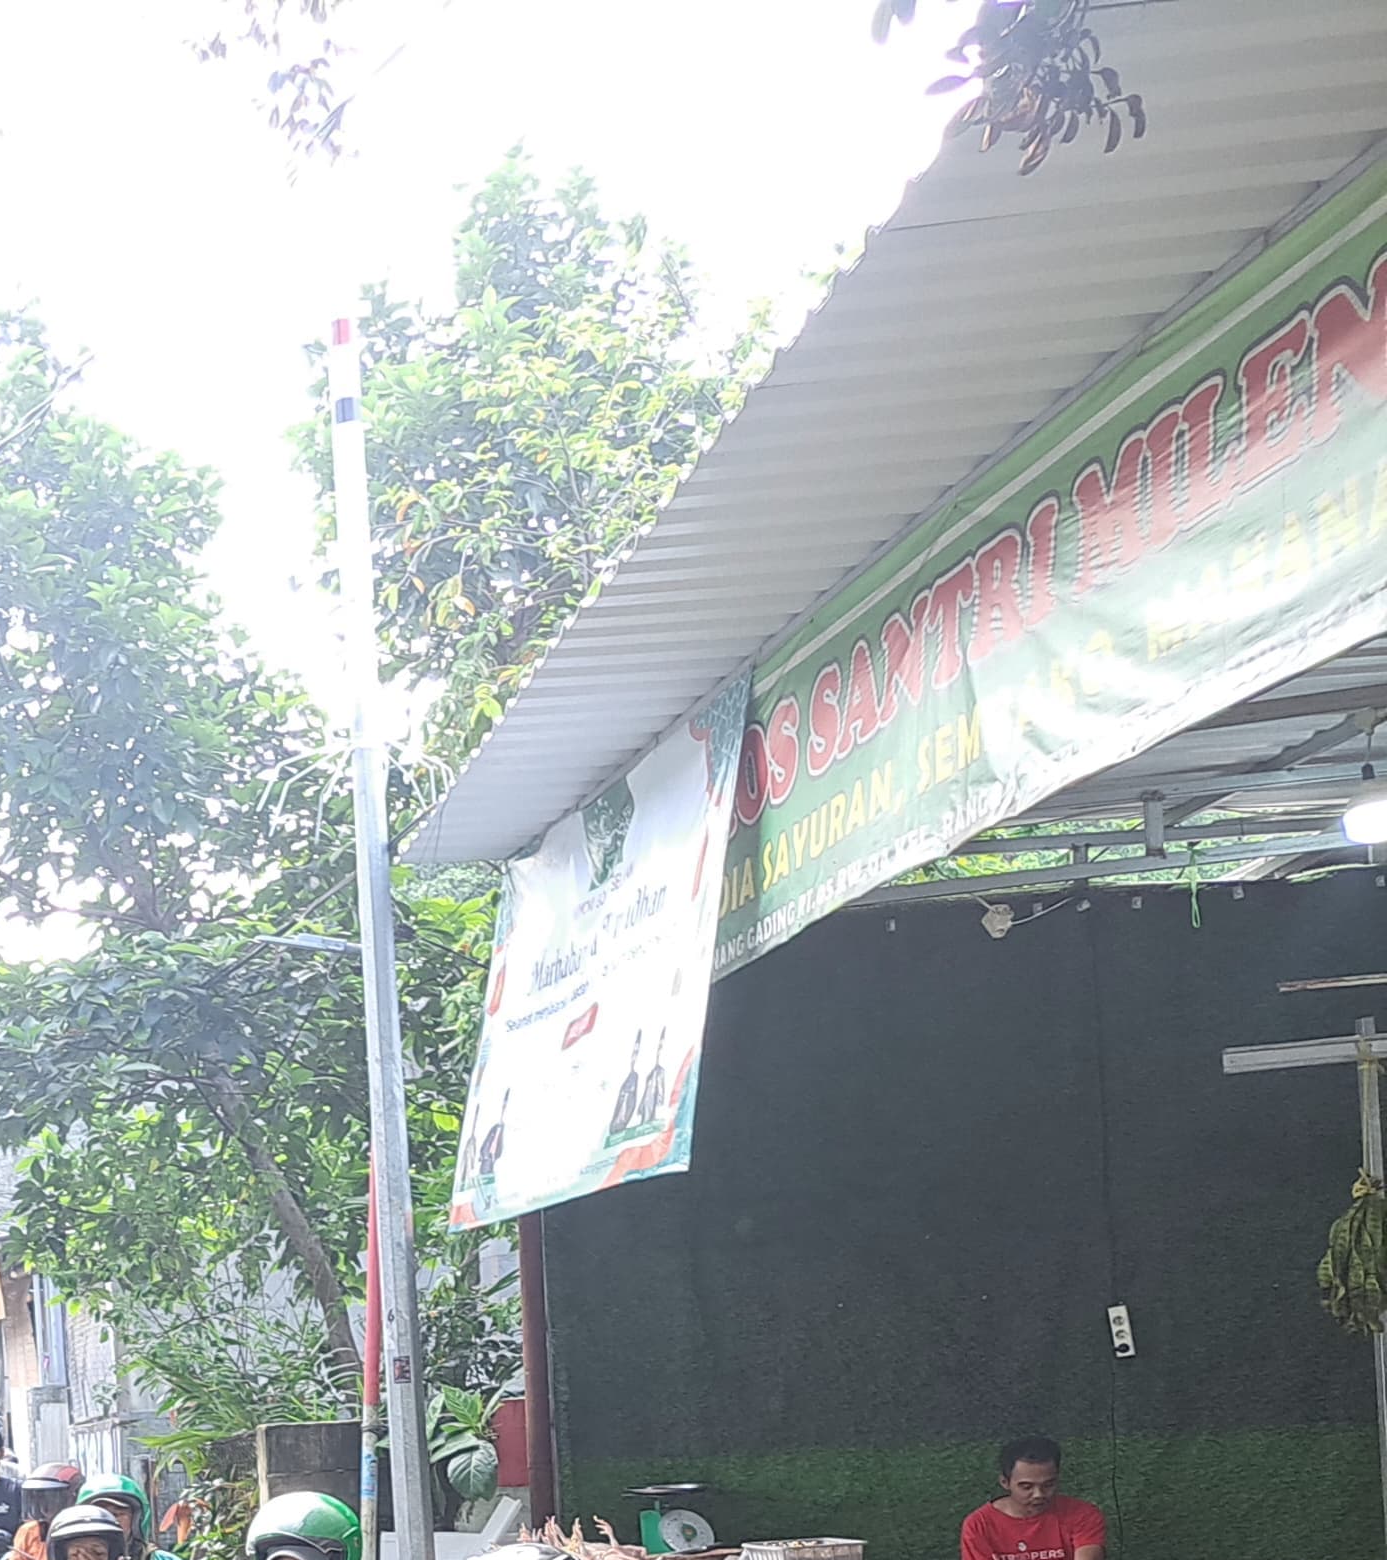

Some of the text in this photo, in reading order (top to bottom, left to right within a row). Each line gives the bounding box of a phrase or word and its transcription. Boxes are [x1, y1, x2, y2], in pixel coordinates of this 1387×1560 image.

[730, 697, 800, 838] OS
[807, 494, 1060, 778] SANTRI
[763, 760, 904, 892] SAYURAN,
[747, 900, 795, 949] GADING
